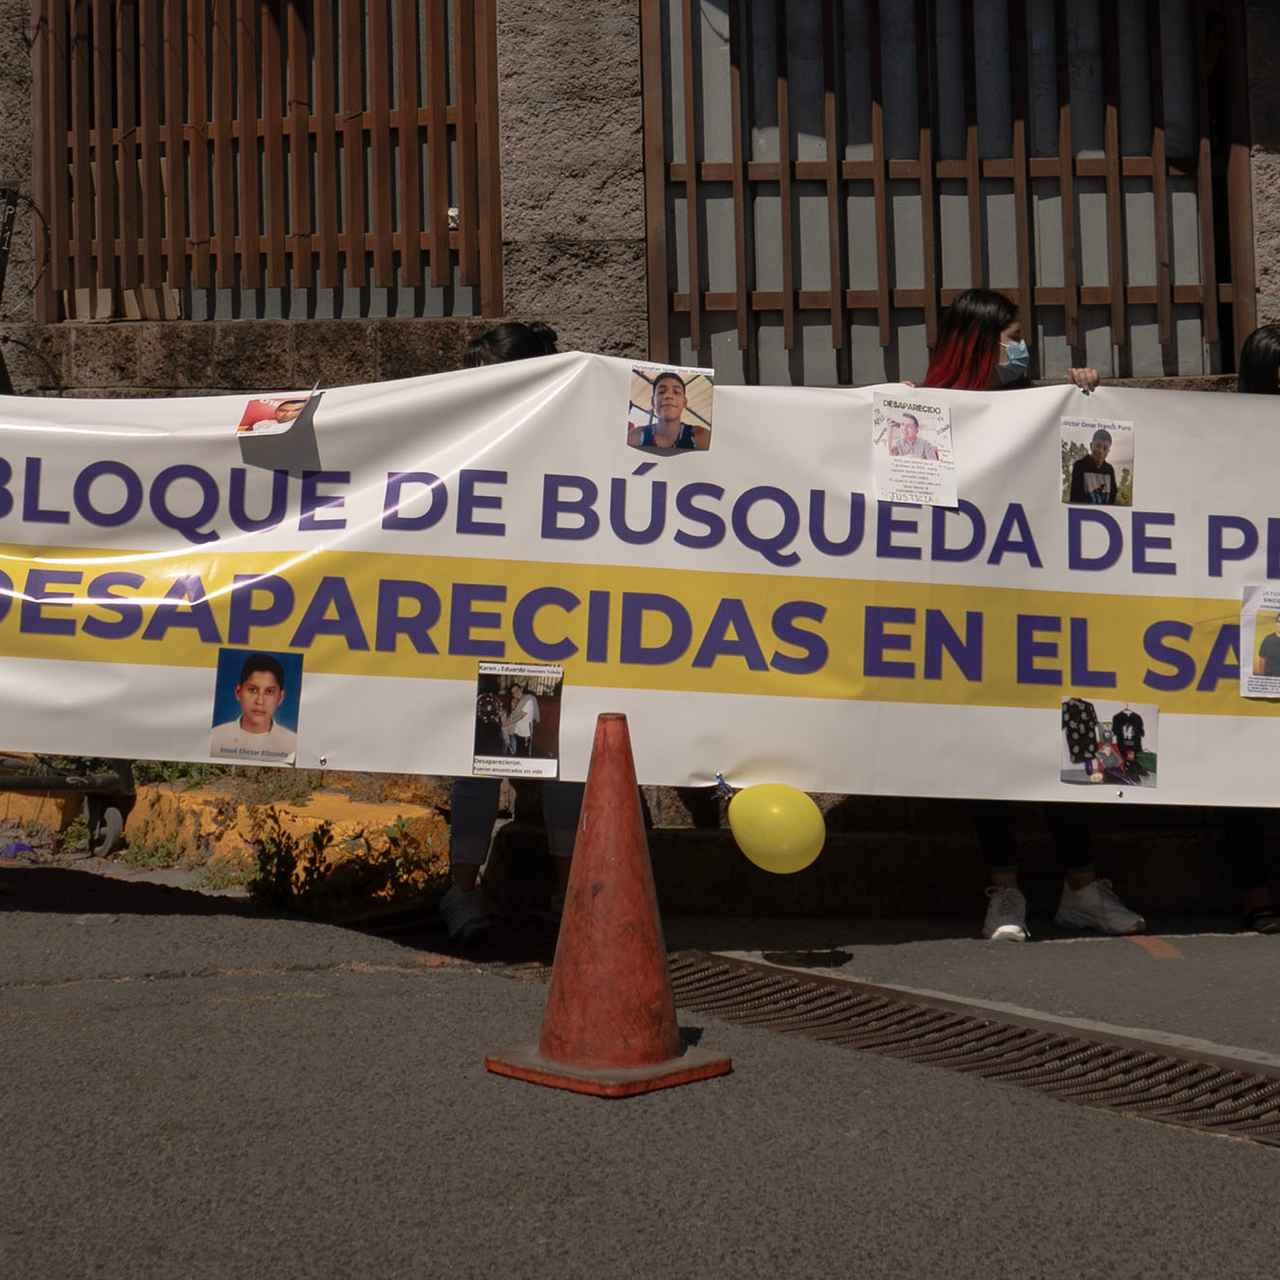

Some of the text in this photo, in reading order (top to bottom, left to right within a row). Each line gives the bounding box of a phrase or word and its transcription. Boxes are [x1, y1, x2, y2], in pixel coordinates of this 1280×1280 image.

[382, 472, 508, 538] DE
[542, 461, 1042, 570] BÚSQUEDA
[1068, 509, 1178, 576] DE
[866, 607, 982, 681] EN
[1017, 613, 1117, 688] EL
